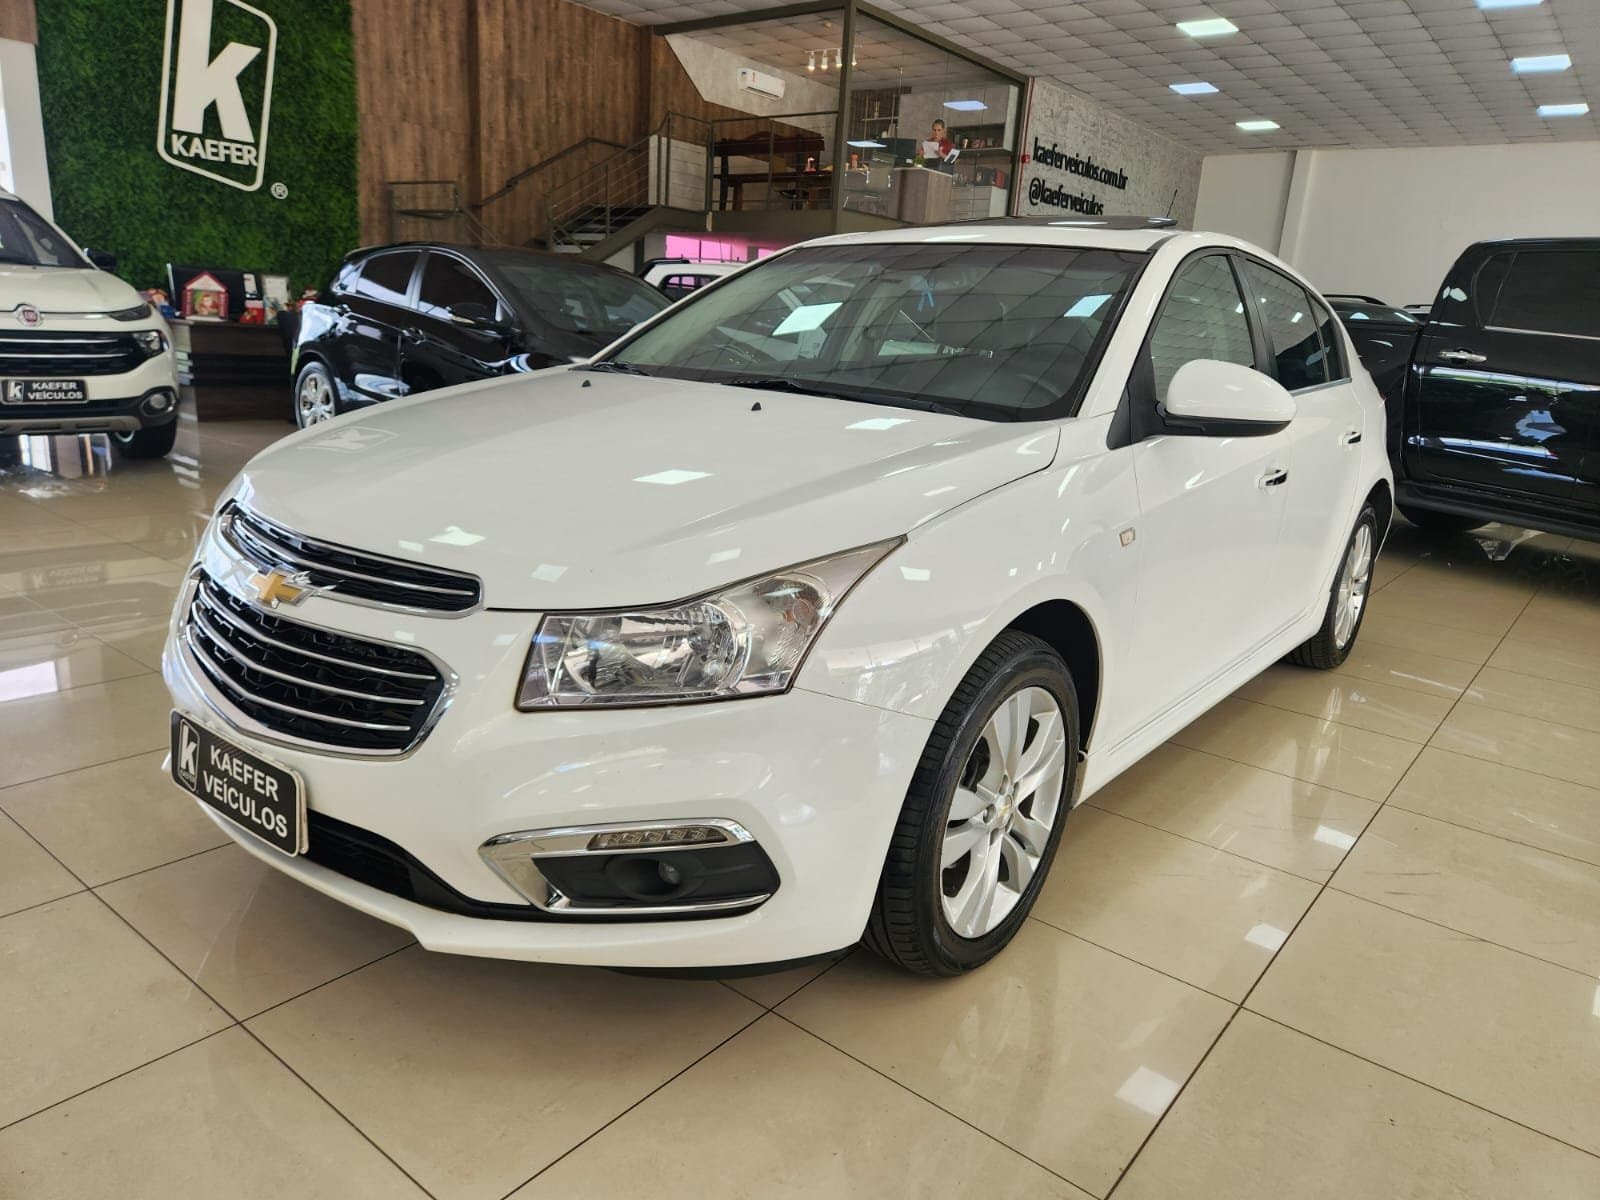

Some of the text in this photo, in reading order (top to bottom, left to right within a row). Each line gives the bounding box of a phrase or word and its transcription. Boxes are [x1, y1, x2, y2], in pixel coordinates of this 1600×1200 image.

[171, 133, 259, 167] KAEFER
[1032, 136, 1129, 190] kaeferveiculos.com.br
[1028, 176, 1105, 216] @kaeferveiculos
[27, 390, 84, 400] VEÍCULOS
[31, 381, 78, 391] KAEFER
[210, 744, 279, 802] KAEFER
[203, 769, 289, 839] VEÍCULOS
